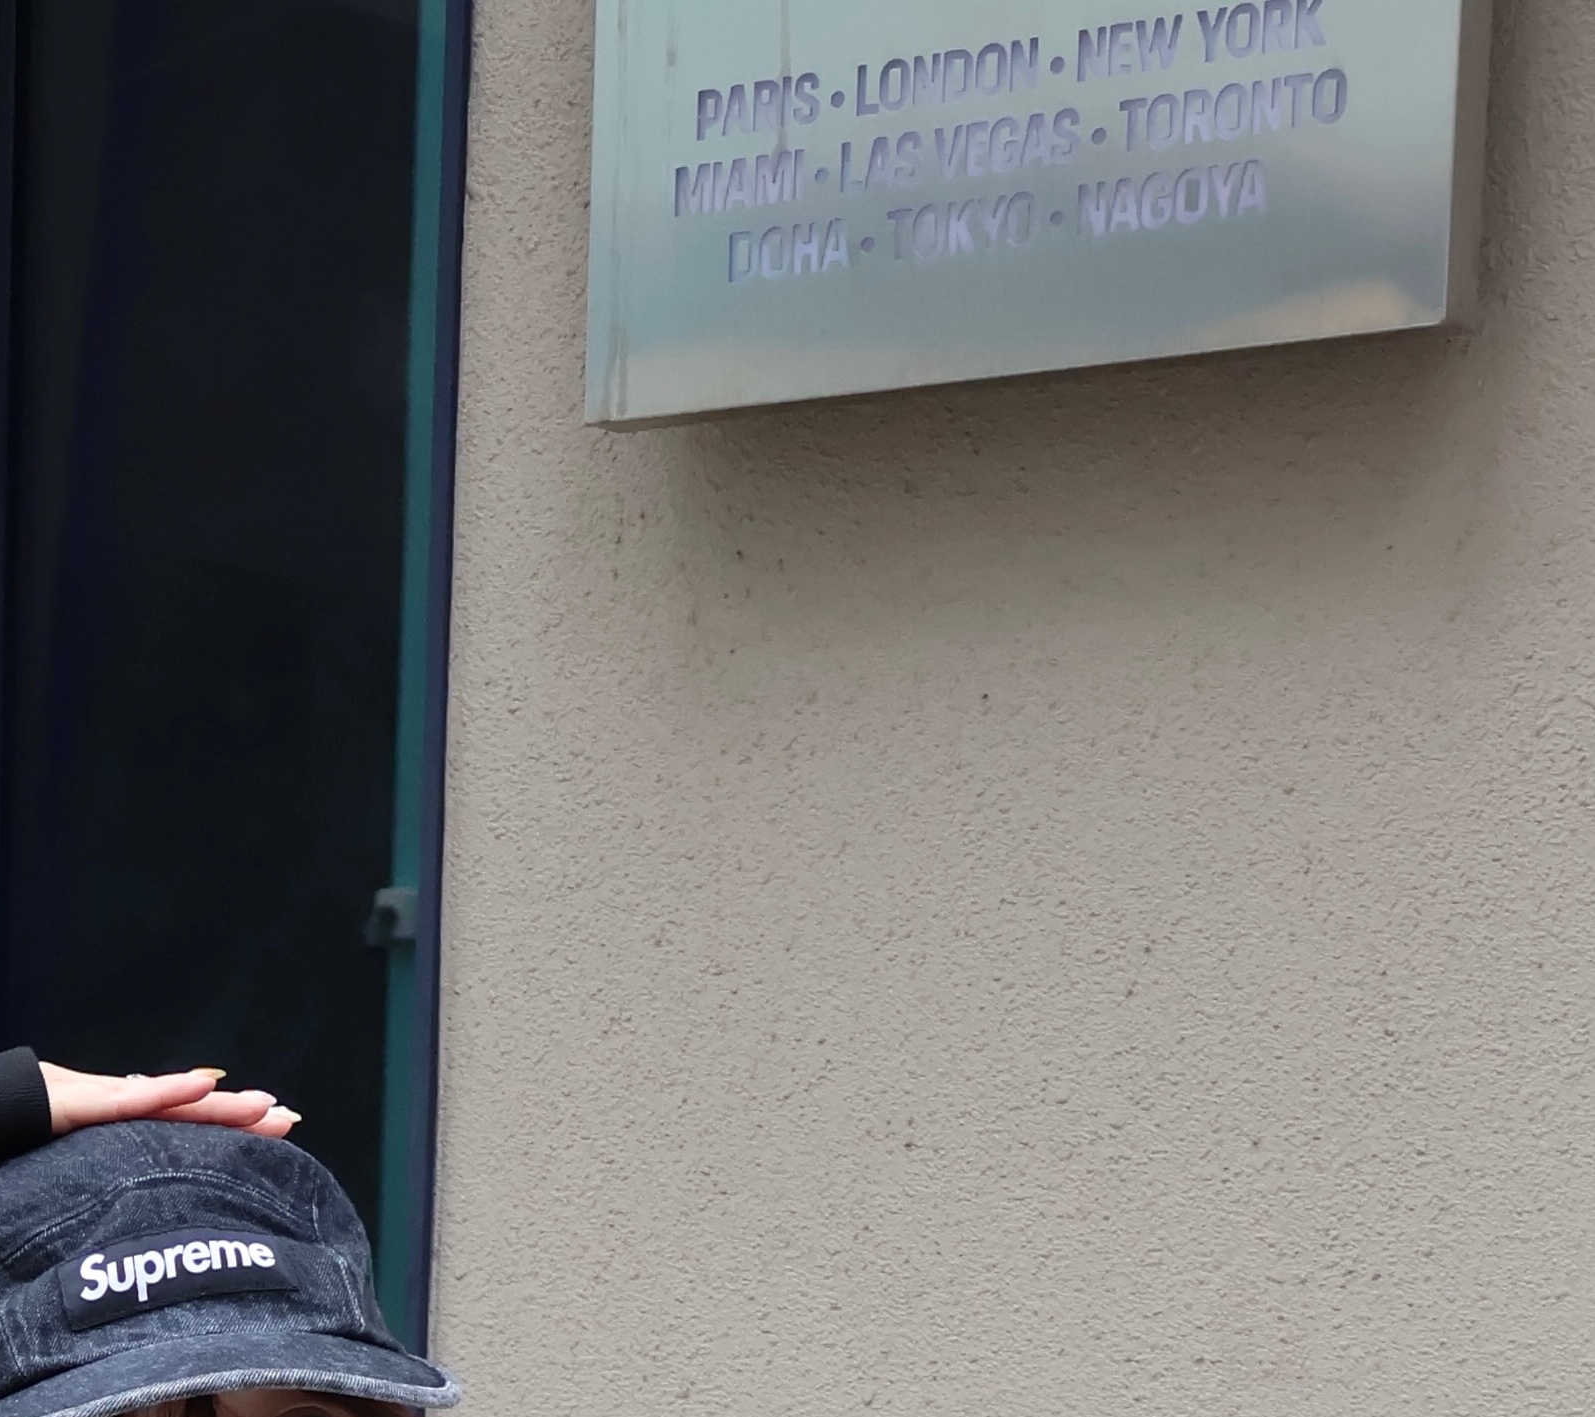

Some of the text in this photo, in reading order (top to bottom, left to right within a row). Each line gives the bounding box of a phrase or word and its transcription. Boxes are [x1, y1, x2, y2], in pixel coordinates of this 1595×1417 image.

[697, 0, 1326, 141] PARIS LONDON NEW YORK
[675, 68, 1347, 217] MIAMI LAS VEGAS TORONTO
[728, 160, 1268, 283] DOHA TOKYO NAGOYA
[80, 1239, 276, 1302] Supreme
